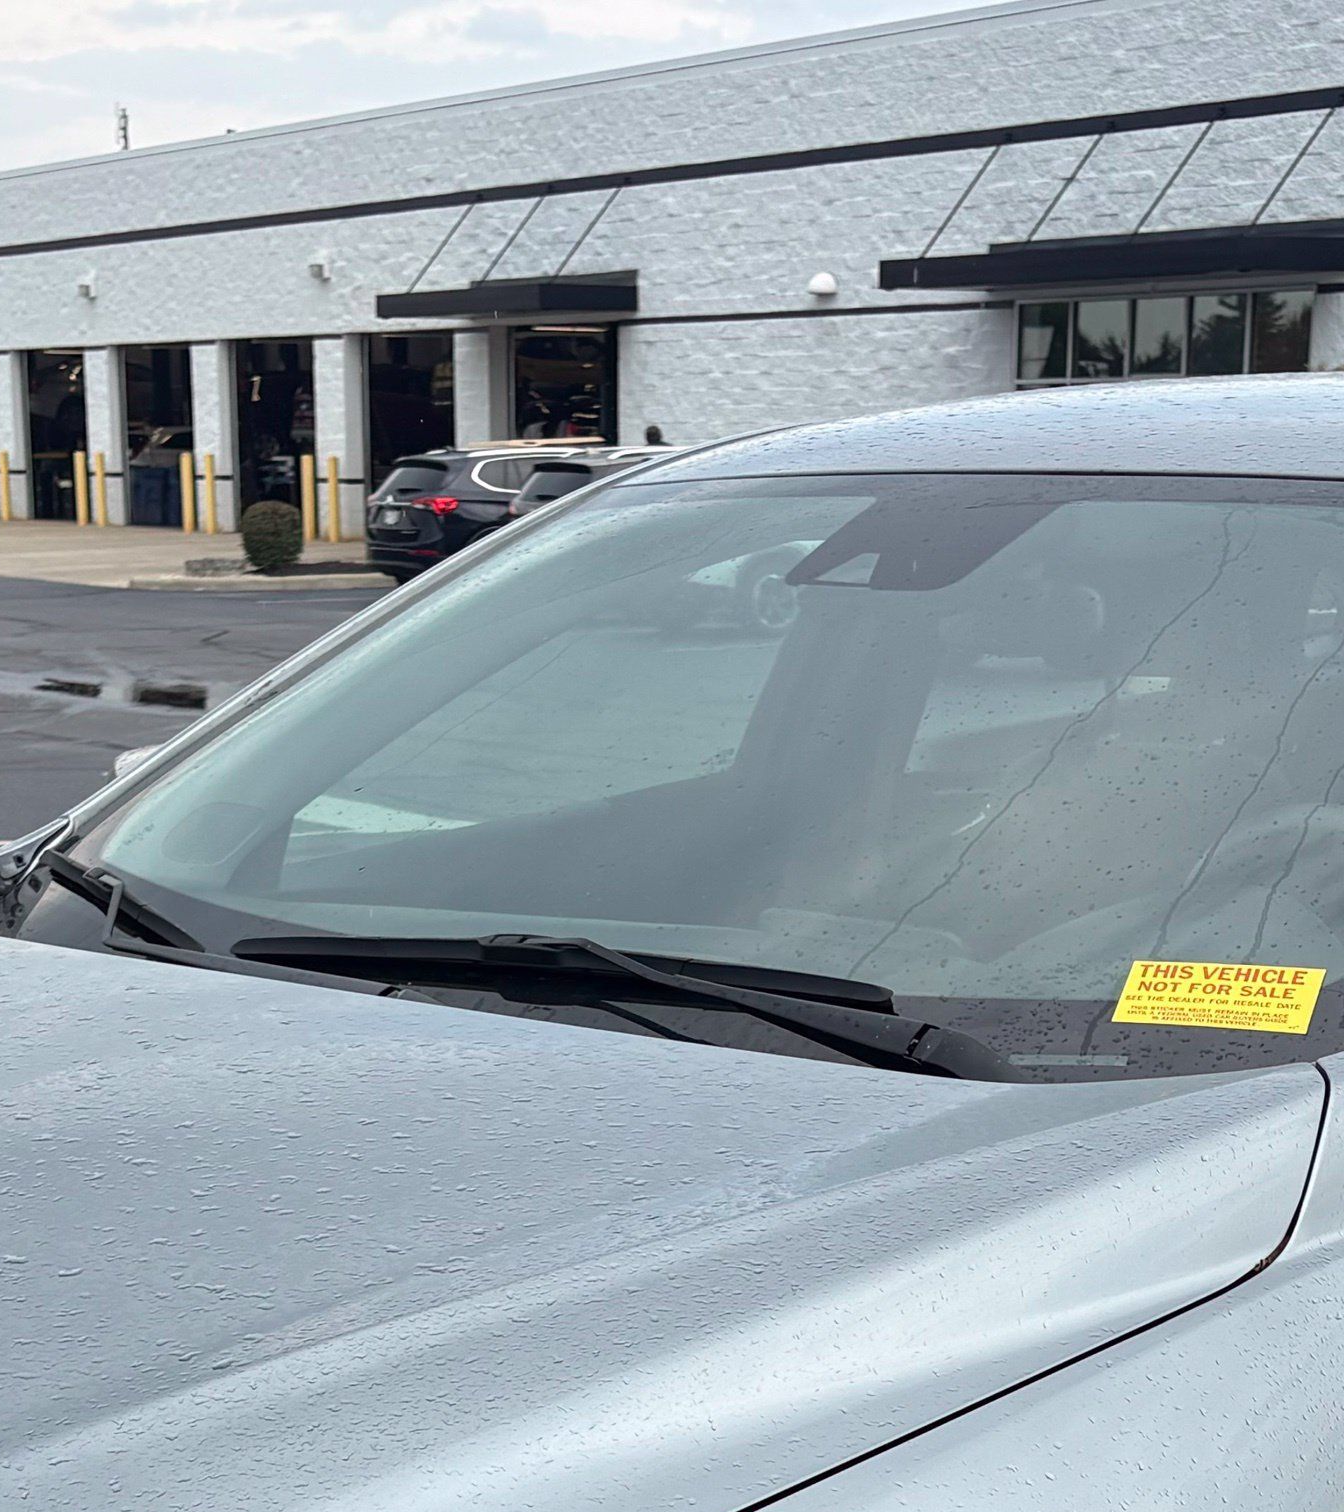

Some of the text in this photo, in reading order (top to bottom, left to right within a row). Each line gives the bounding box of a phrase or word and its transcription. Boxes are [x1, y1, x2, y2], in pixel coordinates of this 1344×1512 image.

[1140, 964, 1308, 986] THIS VEHICLE
[1137, 981, 1297, 1000] NOT FOR SALE
[1233, 1000, 1271, 1008] RESALE
[1276, 1002, 1302, 1010] DATE
